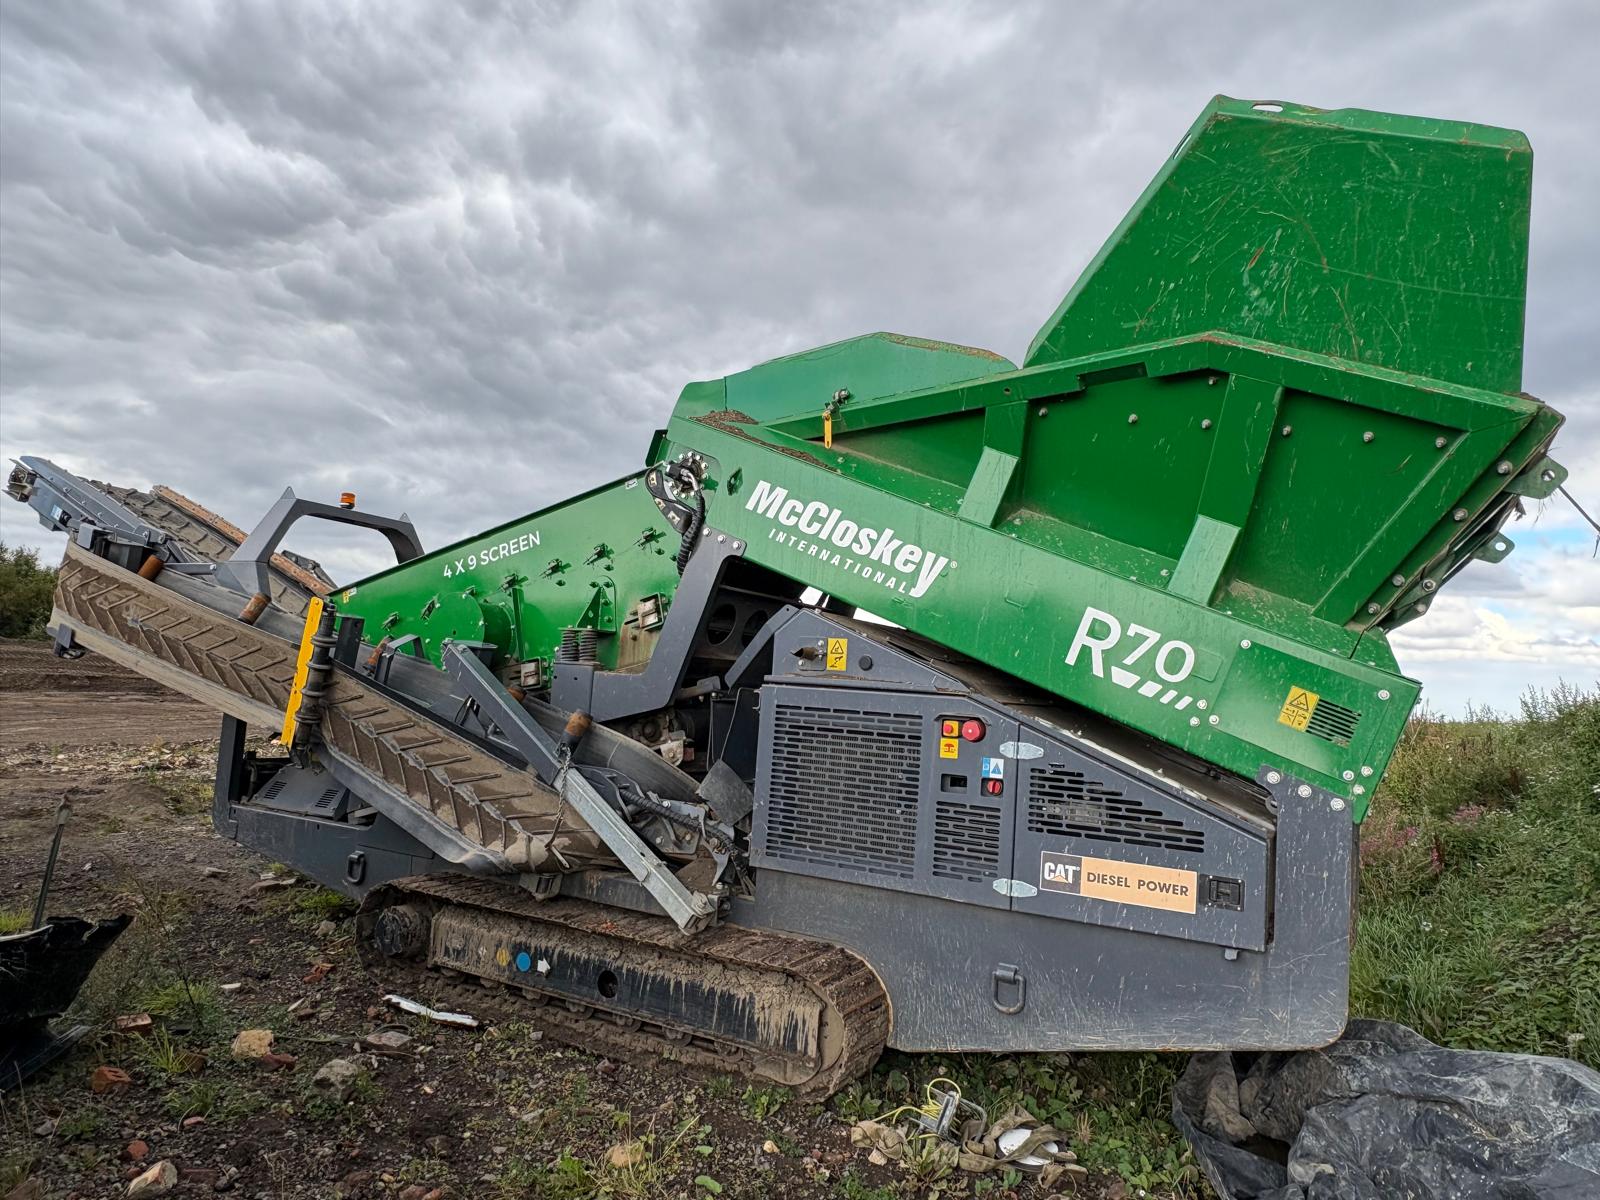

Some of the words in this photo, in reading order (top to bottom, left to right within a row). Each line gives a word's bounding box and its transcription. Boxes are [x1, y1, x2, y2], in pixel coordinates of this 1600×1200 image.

[443, 564, 452, 578] 4
[455, 559, 465, 575] X
[468, 555, 477, 570] 9
[480, 531, 541, 565] SCREEN
[745, 480, 949, 598] McCloskey
[768, 528, 907, 595] INTERNATIONAL
[1064, 606, 1194, 682] R70
[1044, 862, 1078, 884] CAT
[1086, 871, 1131, 888] DIESEL
[1137, 879, 1189, 897] POWER
